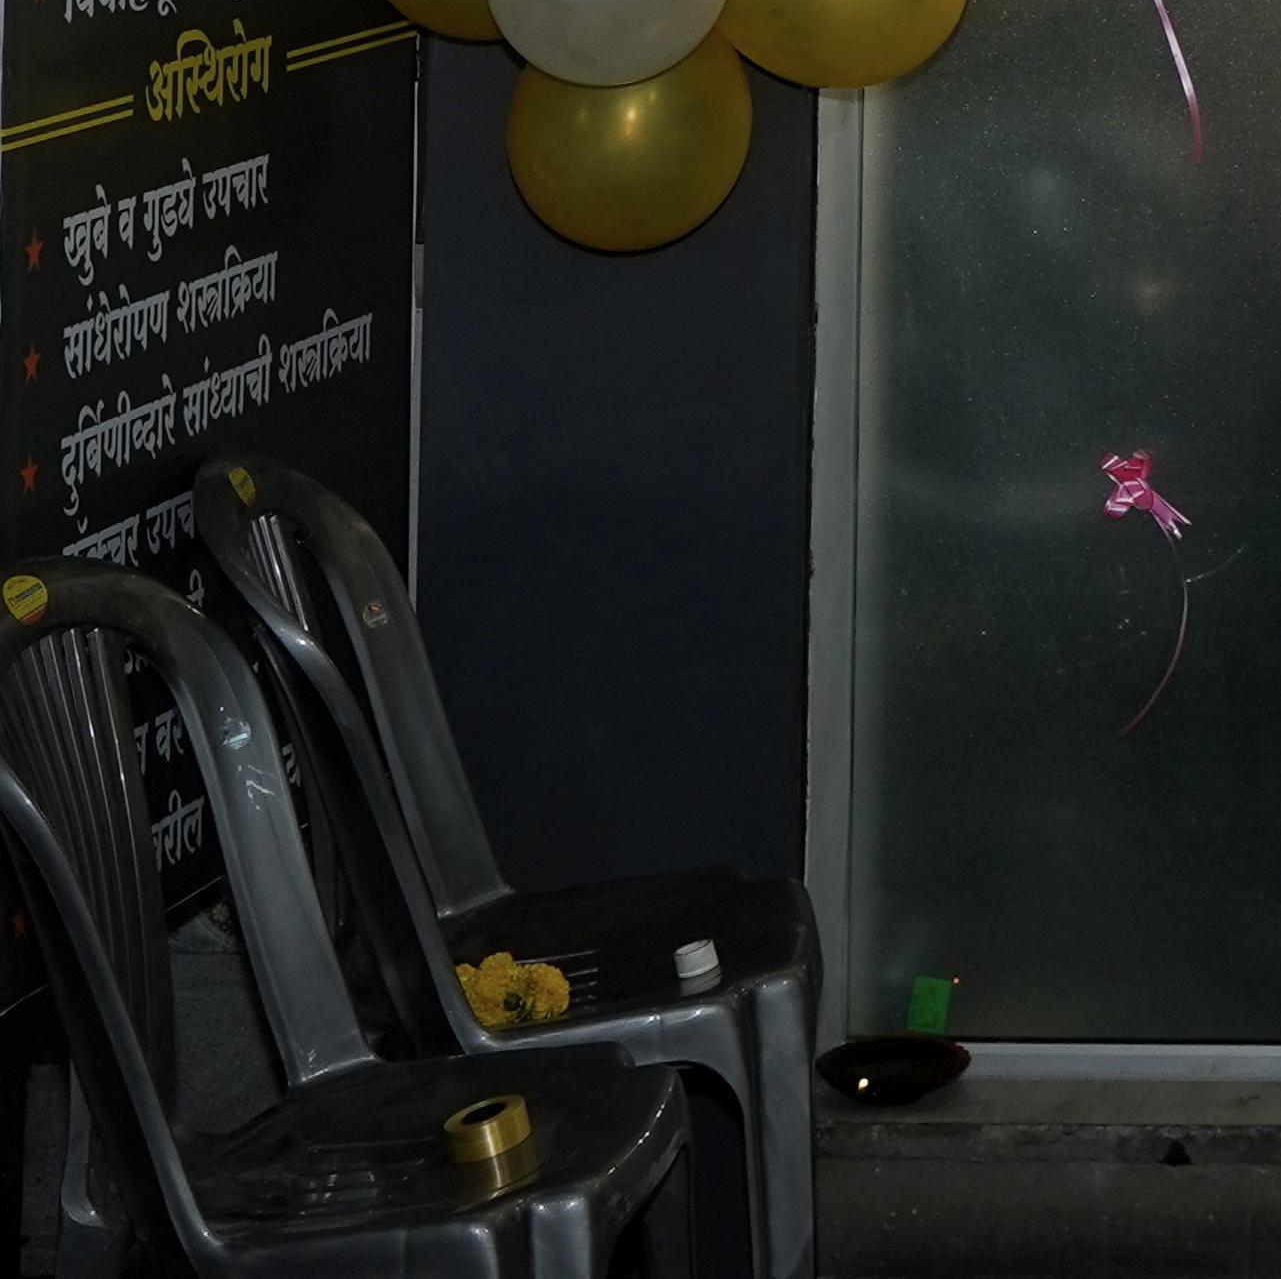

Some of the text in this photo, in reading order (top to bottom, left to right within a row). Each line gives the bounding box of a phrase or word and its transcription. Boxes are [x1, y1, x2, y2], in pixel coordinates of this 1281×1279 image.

[146, 19, 272, 121] अस्थिरोग
[63, 154, 269, 285] खुबे व गुडघे उपचार
[64, 245, 277, 378] सांधेरोपण शस्त्रक्रिया
[183, 334, 272, 436] सांध्याची
[279, 309, 372, 392] शस्त्रक्रिया
